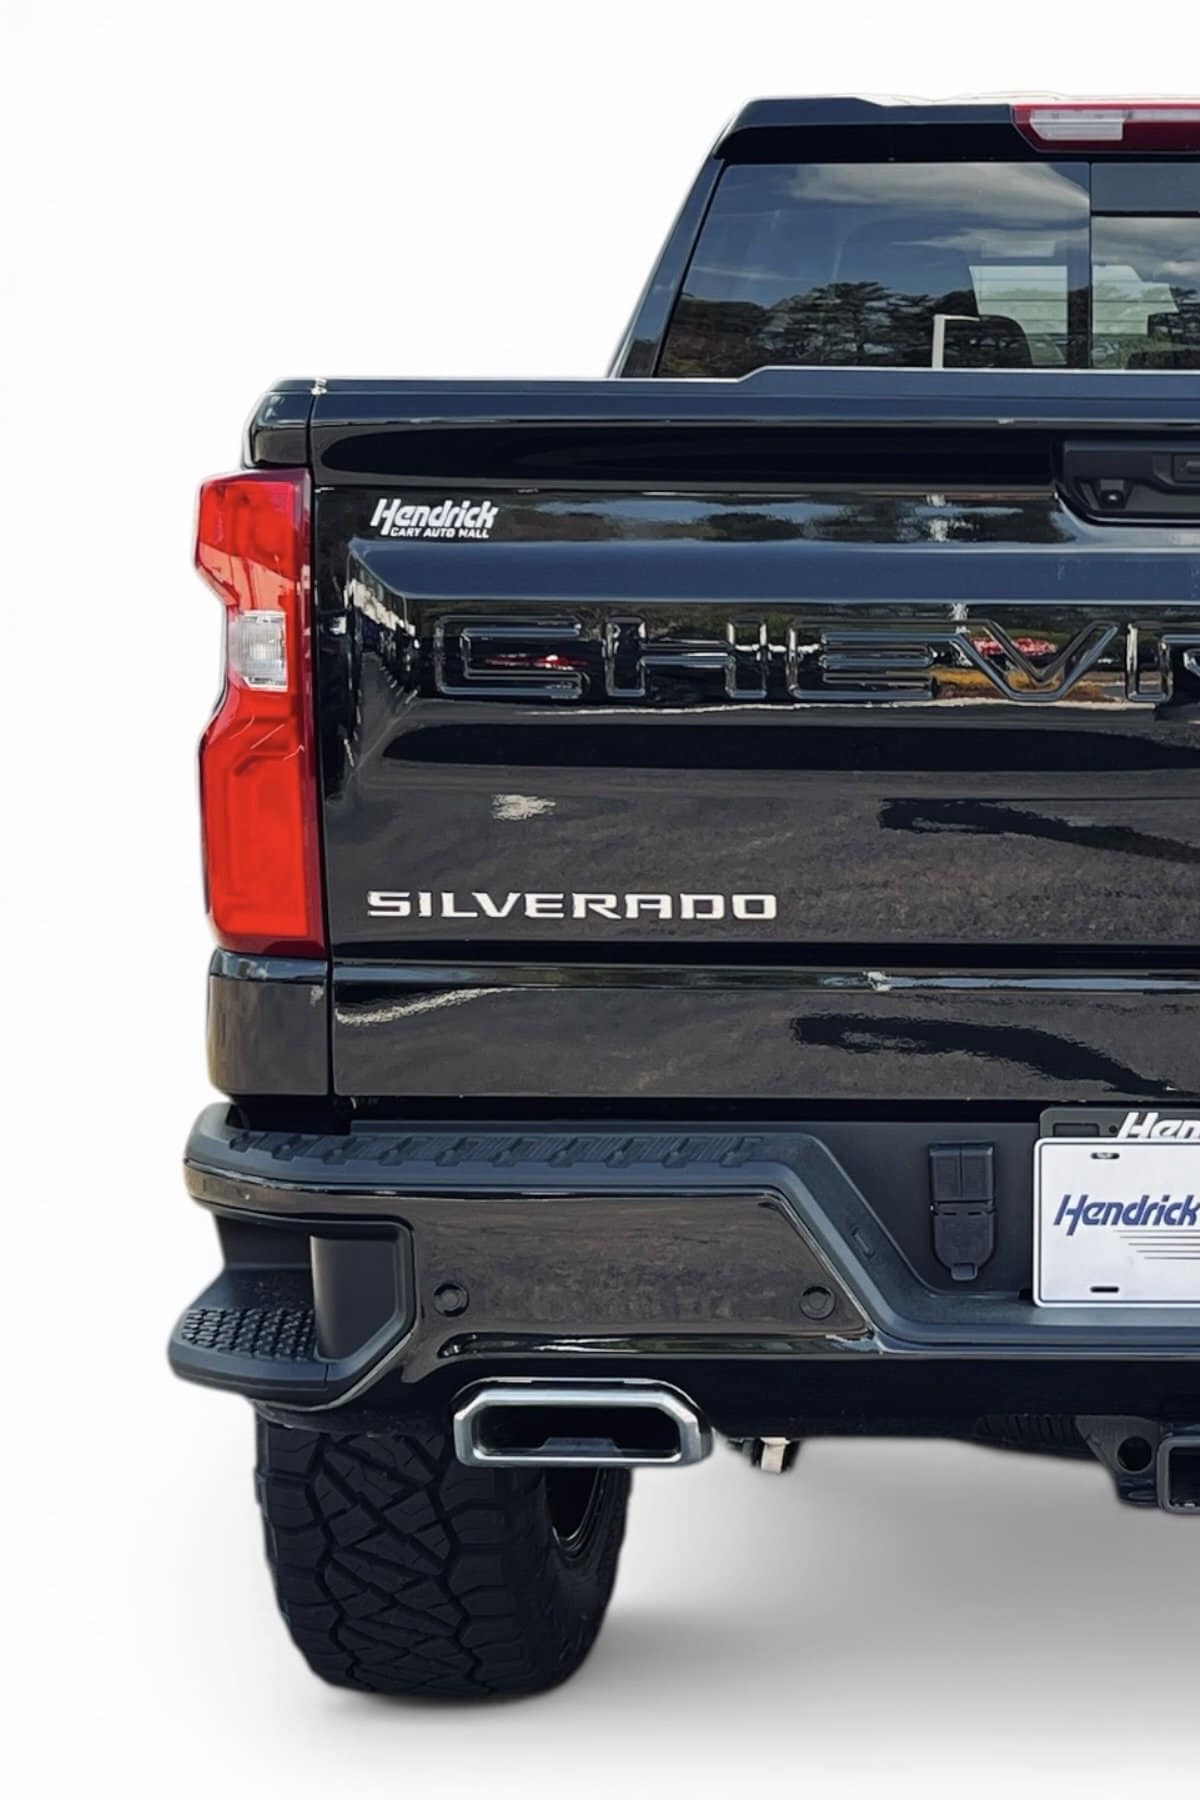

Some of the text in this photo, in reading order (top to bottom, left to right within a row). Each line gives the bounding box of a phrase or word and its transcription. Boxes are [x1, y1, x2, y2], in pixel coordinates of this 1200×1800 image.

[370, 498, 499, 536] Hendrick
[390, 527, 489, 539] CARY AUTO MALL
[367, 890, 778, 920] SILVERADO
